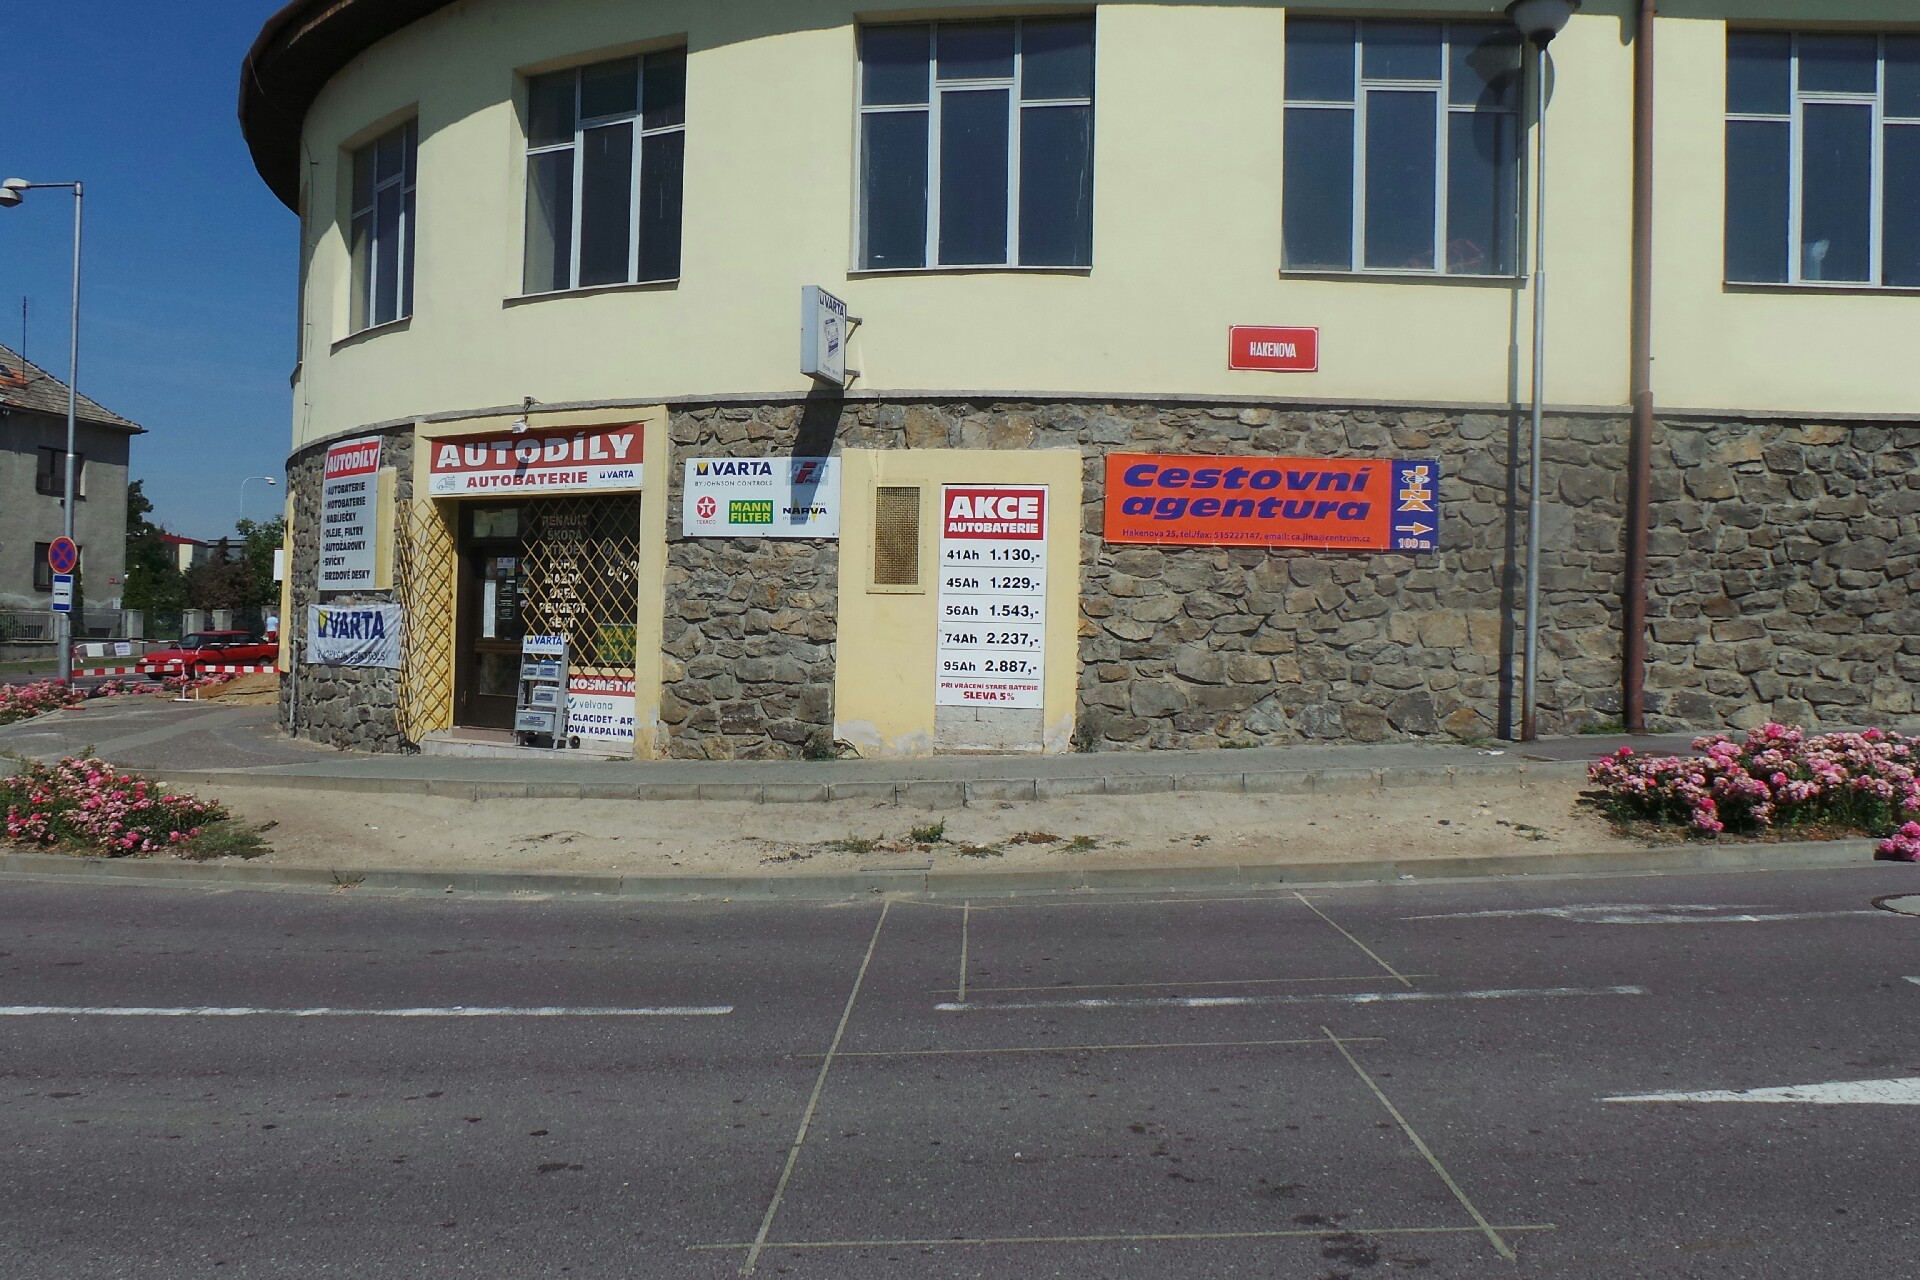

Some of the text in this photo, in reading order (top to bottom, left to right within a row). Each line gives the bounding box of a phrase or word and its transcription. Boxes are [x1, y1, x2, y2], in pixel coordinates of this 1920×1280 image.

[824, 294, 844, 318] VARTA
[1250, 341, 1297, 358] HAKENOVA
[436, 431, 635, 469] AUTODÍLY
[327, 446, 378, 473] AUTODÍLY
[606, 469, 634, 479] VARTA
[712, 461, 773, 476] VARTA
[466, 471, 588, 488] AUTOBATERIE
[1123, 463, 1373, 492] Cestovní
[327, 481, 366, 495] AUTOBATERIE
[326, 496, 366, 510] MOTOBATERIE
[730, 502, 771, 512] MANN
[948, 496, 1039, 520] AKCE
[1121, 496, 1371, 521] agentura
[730, 512, 771, 522] FILTER
[782, 507, 828, 515] NARVA
[325, 526, 364, 539] OLEJE, FILTRY
[948, 522, 1039, 534] AUTOBATERIE
[1122, 528, 1164, 538] Hakenova
[1166, 530, 1179, 539] 25,
[1180, 530, 1212, 539] tel./fax:
[1264, 533, 1290, 541] email:
[1398, 537, 1431, 549] 100 m
[946, 549, 1040, 563] 41Ah 1.130,-
[351, 569, 371, 580] DESKY
[946, 577, 1040, 591] 45Ah 1.229,-
[945, 604, 1039, 619] 56Ah 1.543,-
[329, 610, 385, 639] VARTA
[535, 635, 563, 646] VARTA
[944, 632, 1039, 647] 74Ah 2.237,-
[943, 659, 1037, 675] 95Ah 2.887,-
[963, 690, 998, 701] SLEVA
[579, 699, 613, 710] velvana
[572, 713, 613, 724] GLACIDET
[619, 716, 635, 726] AR
[588, 725, 634, 737] KAPALINA
